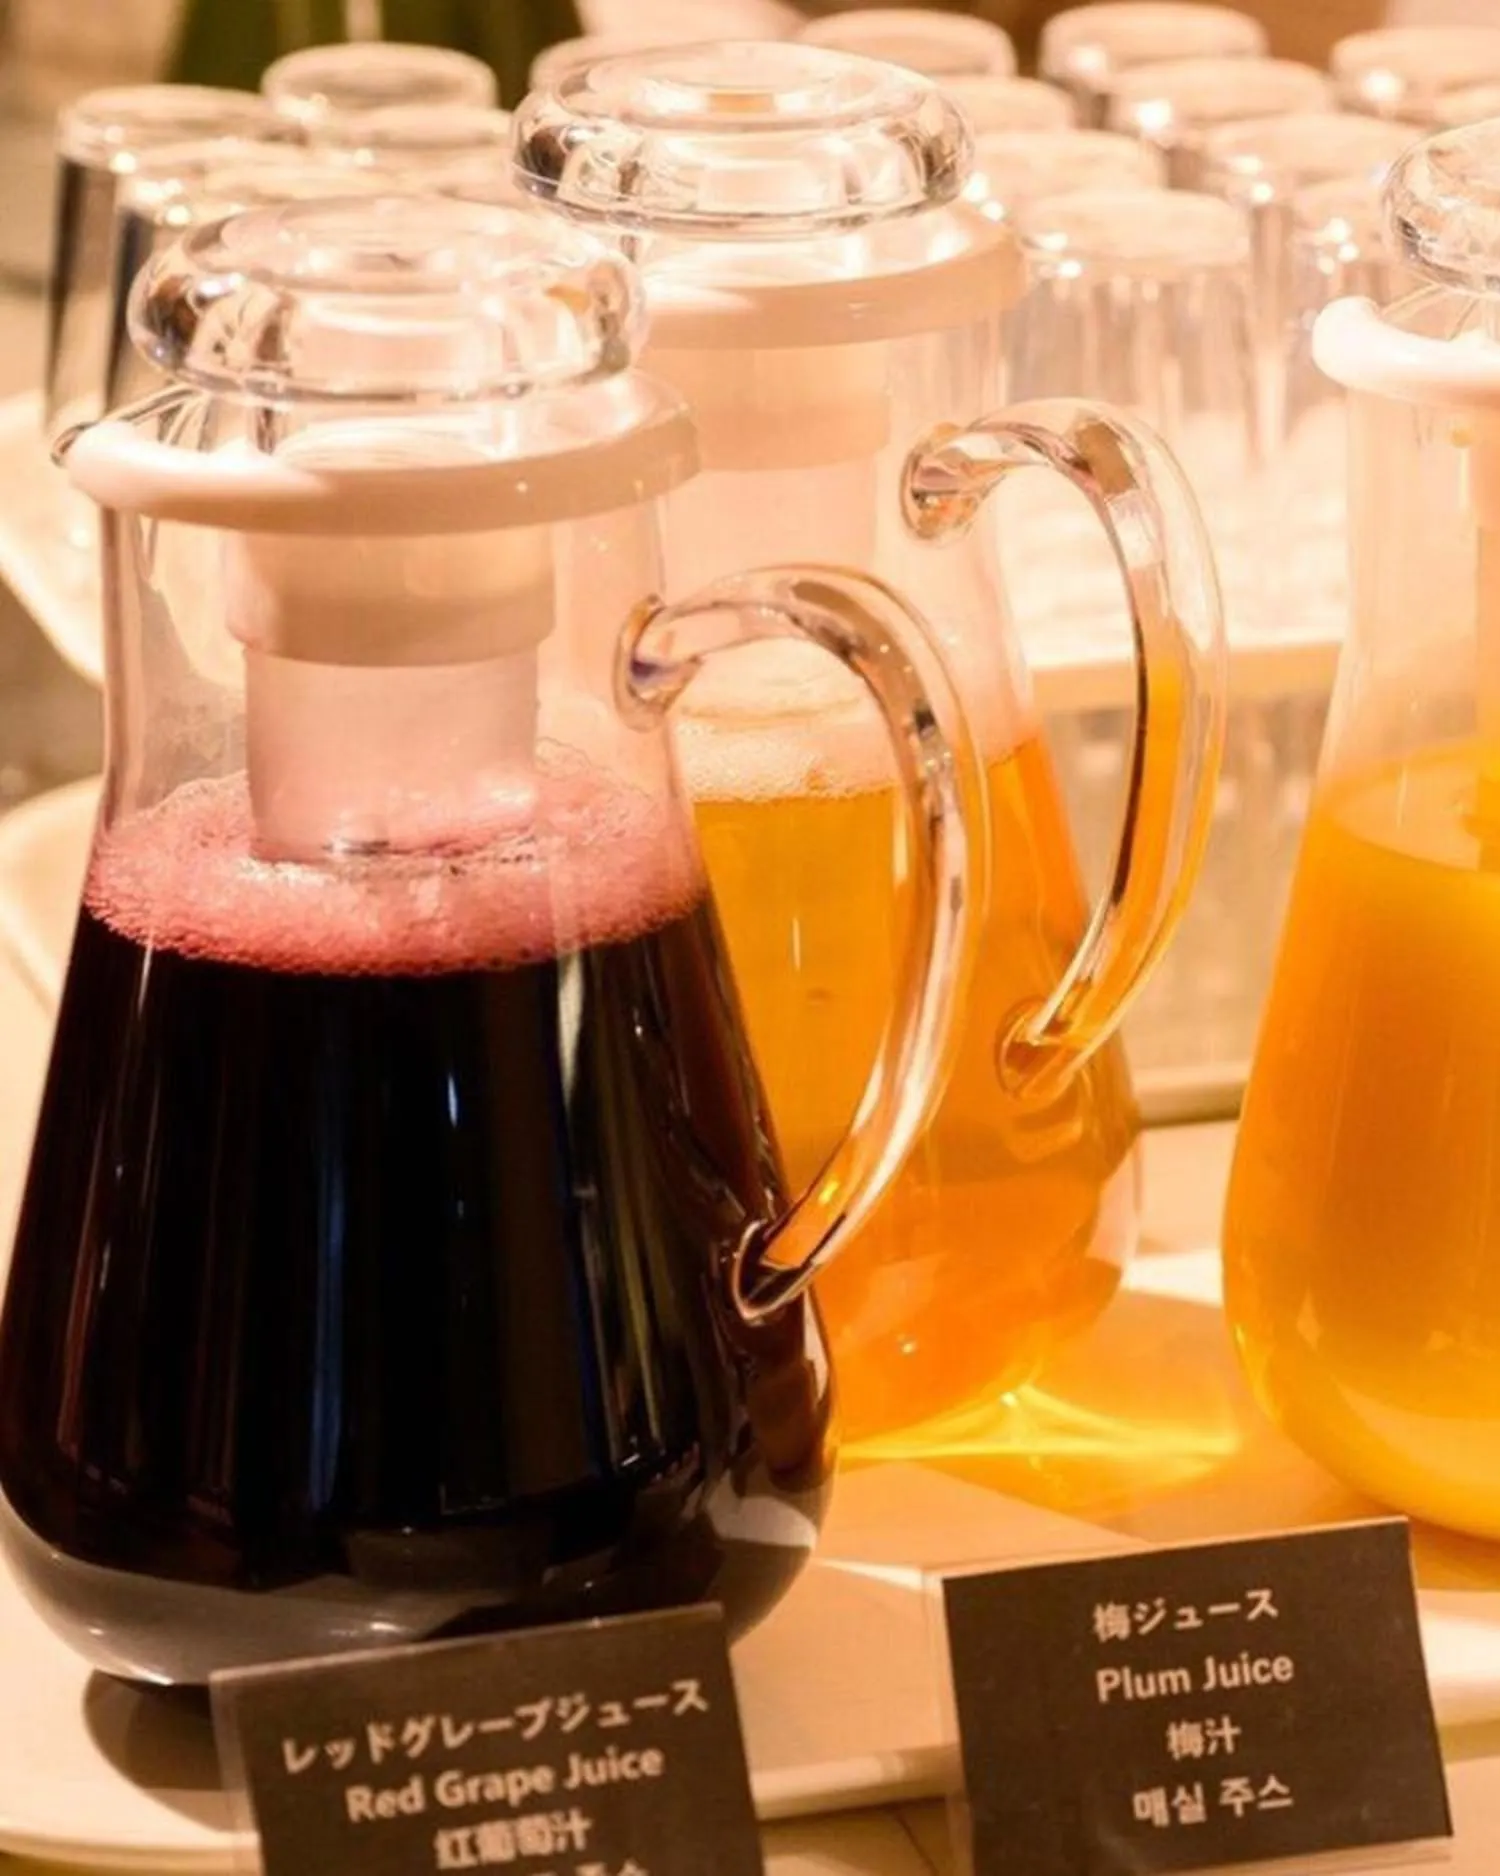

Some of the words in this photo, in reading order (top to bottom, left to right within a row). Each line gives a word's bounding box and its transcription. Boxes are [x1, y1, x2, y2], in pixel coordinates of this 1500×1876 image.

[1096, 1666, 1191, 1702] Plum
[1203, 1652, 1294, 1691] Juice
[283, 1679, 708, 1773] レッドグレープジュース
[346, 1776, 425, 1821] Red
[435, 1766, 554, 1810] Grape
[565, 1745, 663, 1789] Juice
[1133, 1783, 1206, 1826] 매실
[1219, 1775, 1293, 1817] 주스
